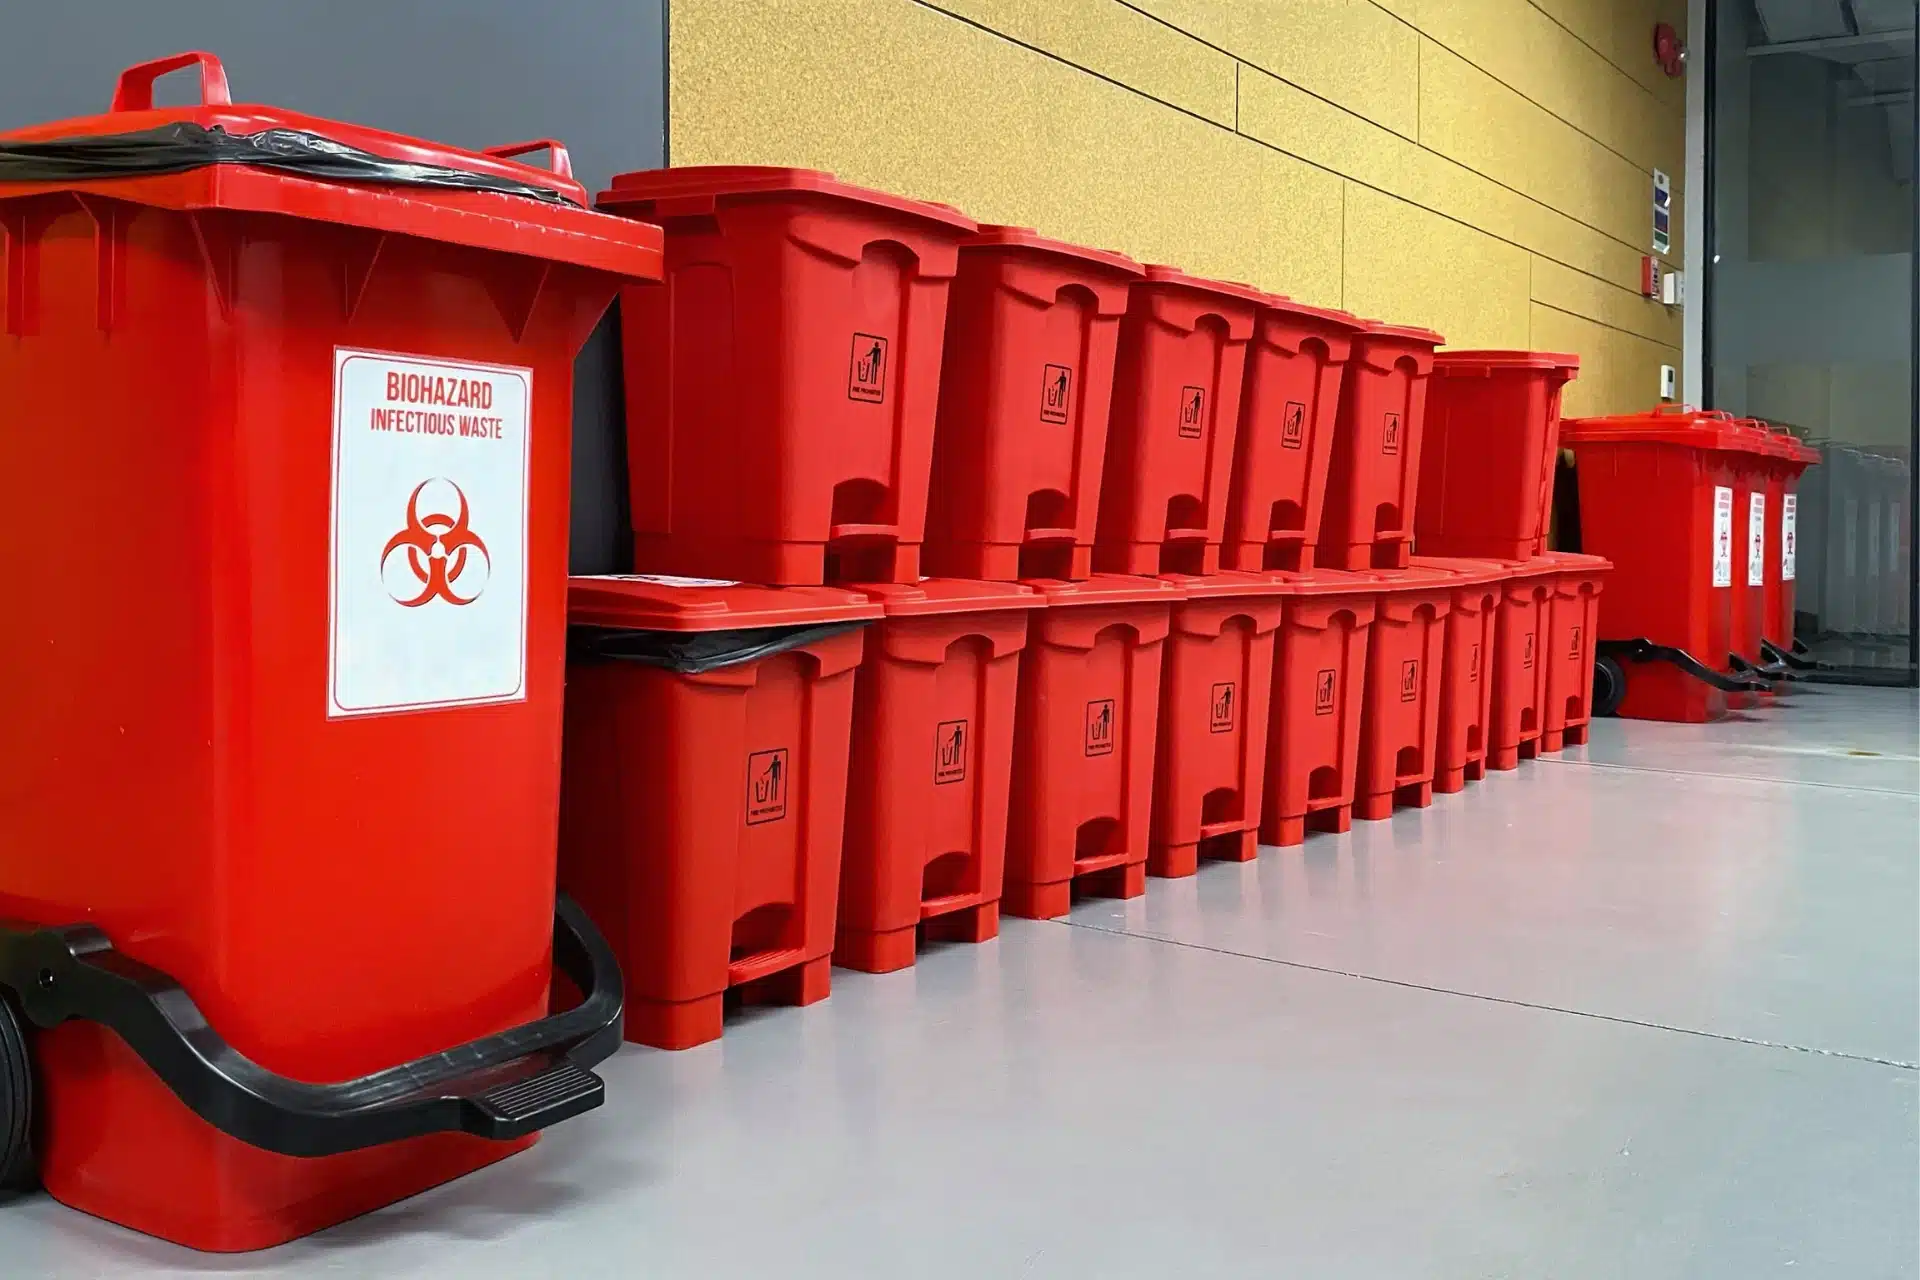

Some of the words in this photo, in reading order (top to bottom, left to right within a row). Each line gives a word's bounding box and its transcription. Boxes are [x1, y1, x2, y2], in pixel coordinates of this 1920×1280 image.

[386, 371, 492, 409] BIOHAZARD
[370, 408, 456, 436] INFECTIOUS
[459, 415, 503, 439] WASTE
